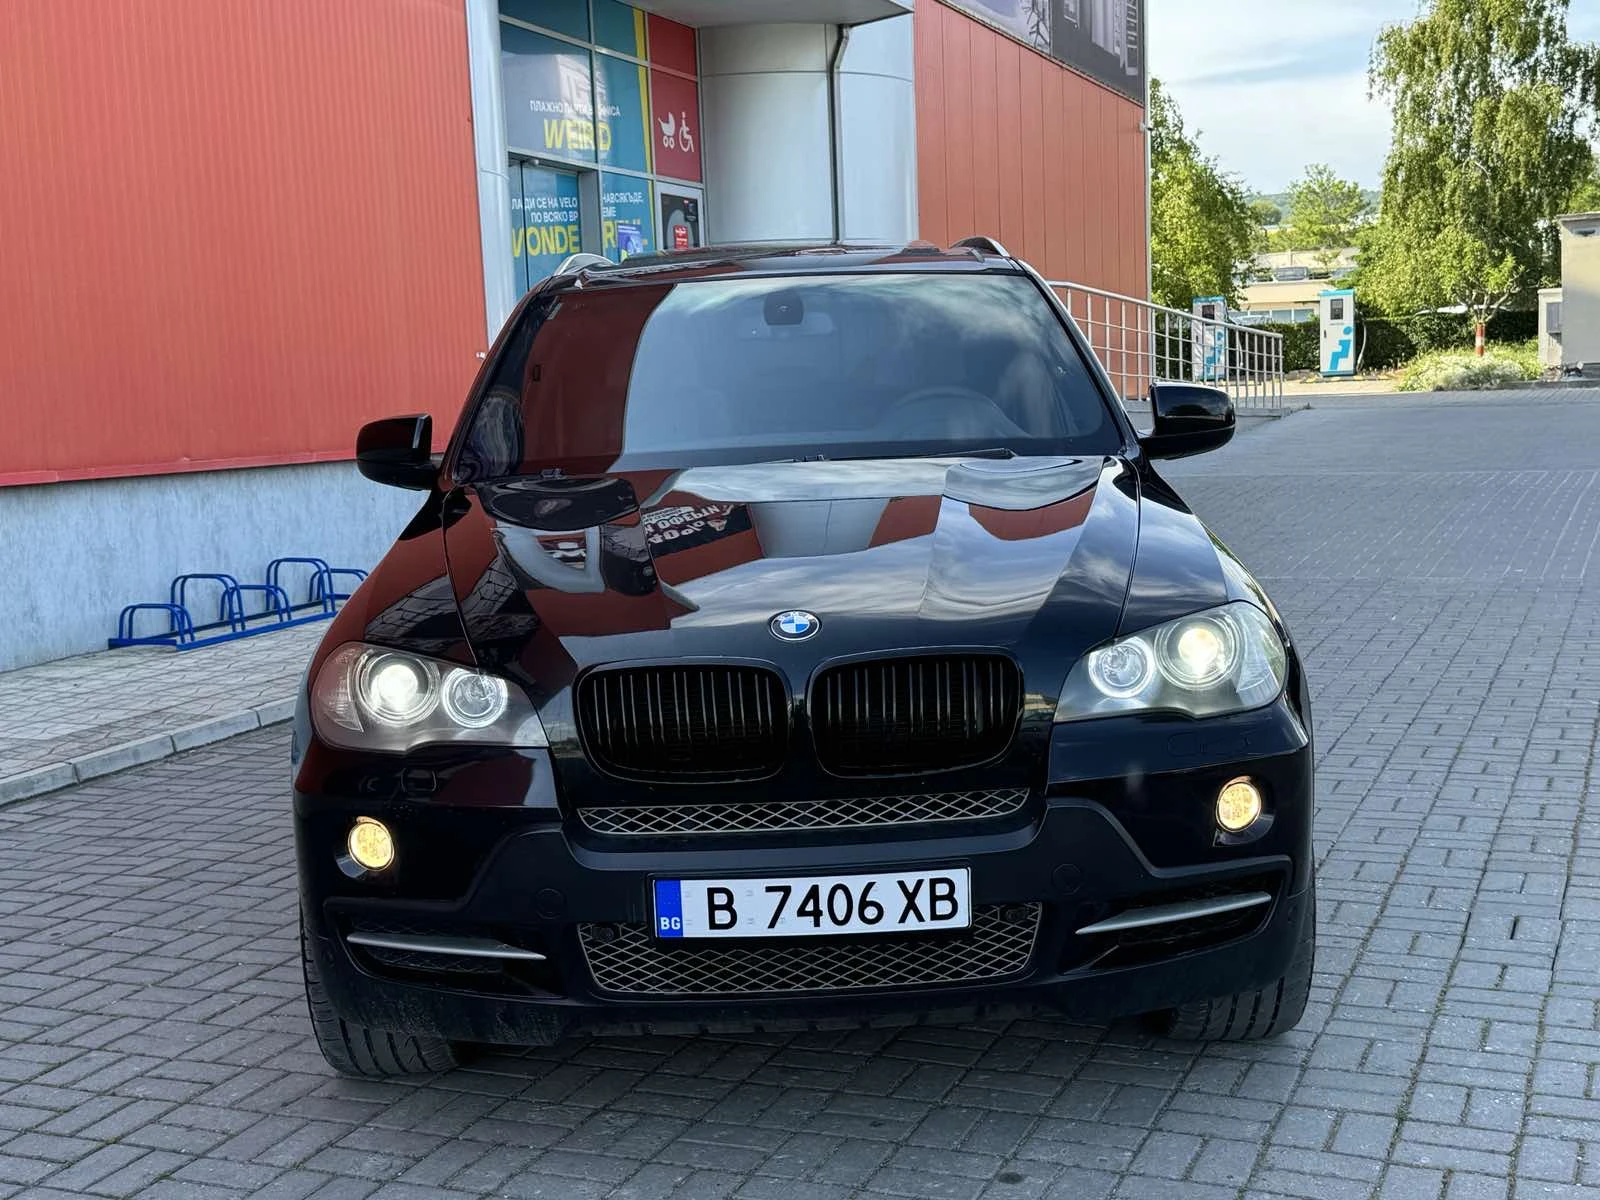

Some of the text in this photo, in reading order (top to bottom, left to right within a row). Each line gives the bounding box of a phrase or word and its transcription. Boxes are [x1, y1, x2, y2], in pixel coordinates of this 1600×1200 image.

[536, 198, 547, 209] СЕ
[547, 197, 559, 209] НА
[559, 196, 578, 208] VELO
[530, 211, 542, 223] ПО
[707, 877, 959, 930] B 7406 XB
[660, 916, 681, 930] BG
